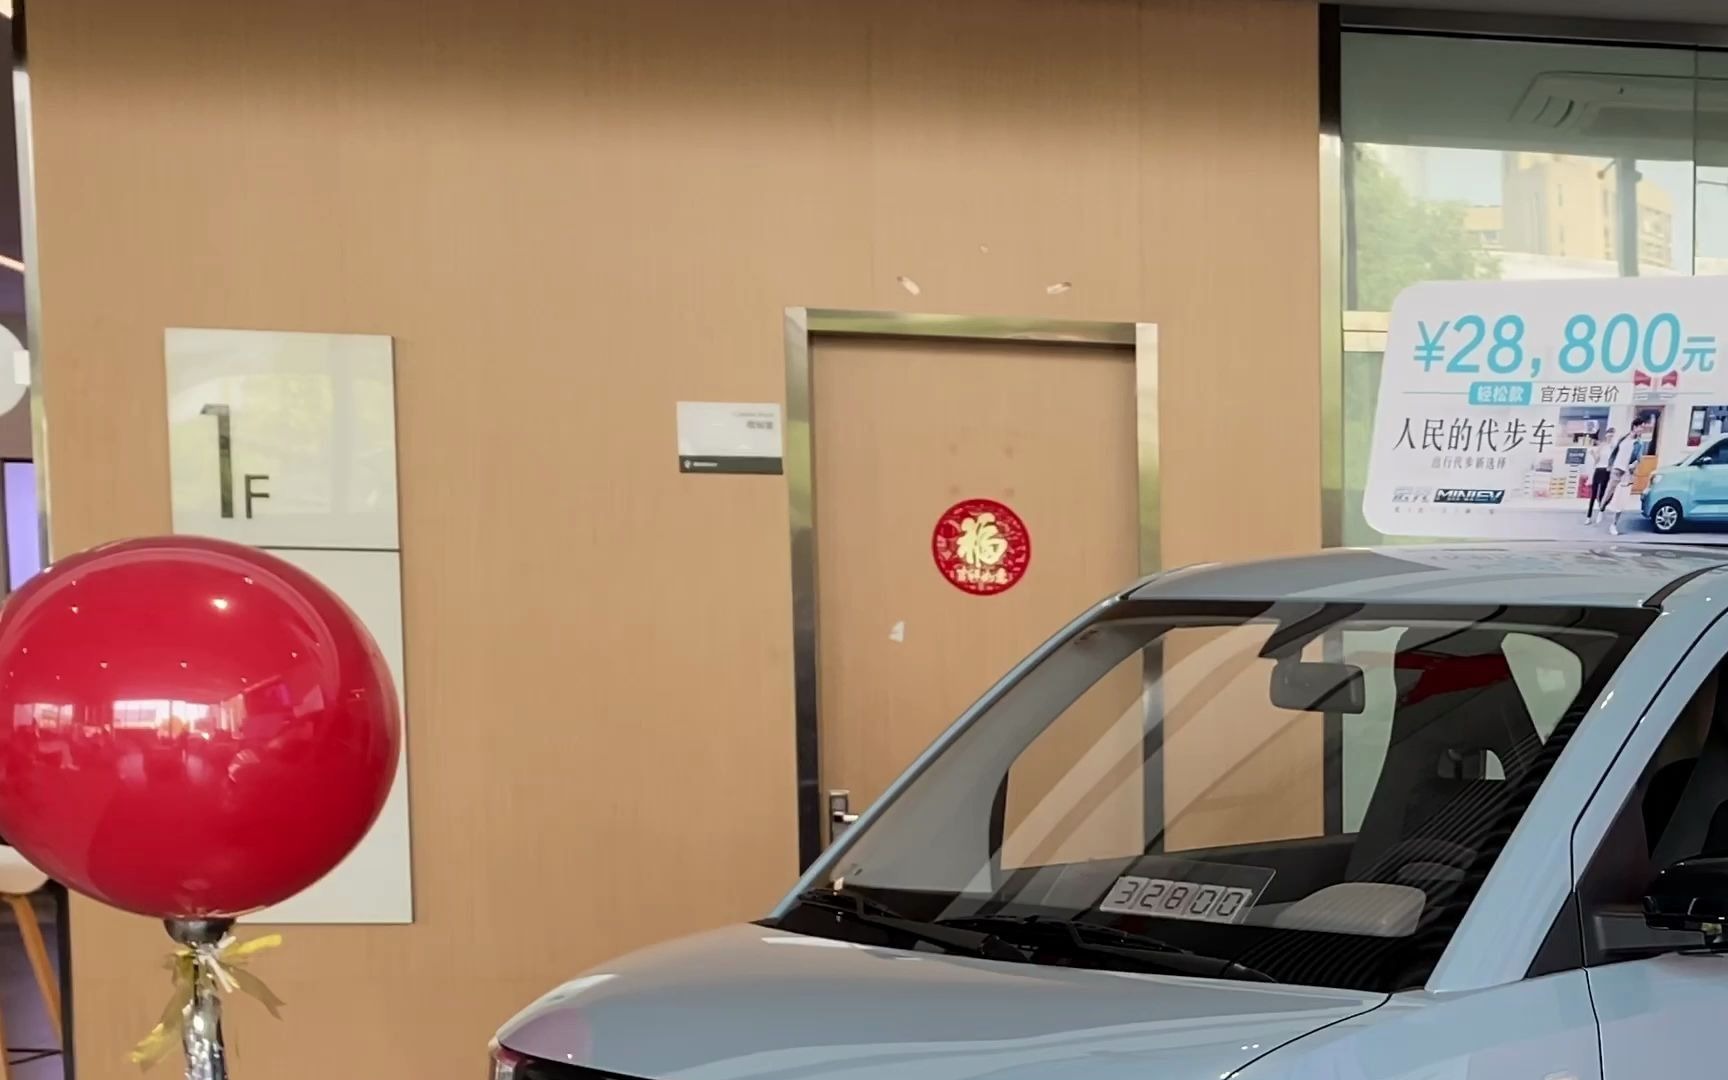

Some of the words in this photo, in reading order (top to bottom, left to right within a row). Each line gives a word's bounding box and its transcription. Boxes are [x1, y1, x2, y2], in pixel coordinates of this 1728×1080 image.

[1477, 385, 1524, 403] 轻松款
[1541, 384, 1620, 404] 官方指导价
[1393, 417, 1555, 453] 人民的代步车
[956, 512, 1008, 568] 福
[1114, 881, 1244, 916] 32800
